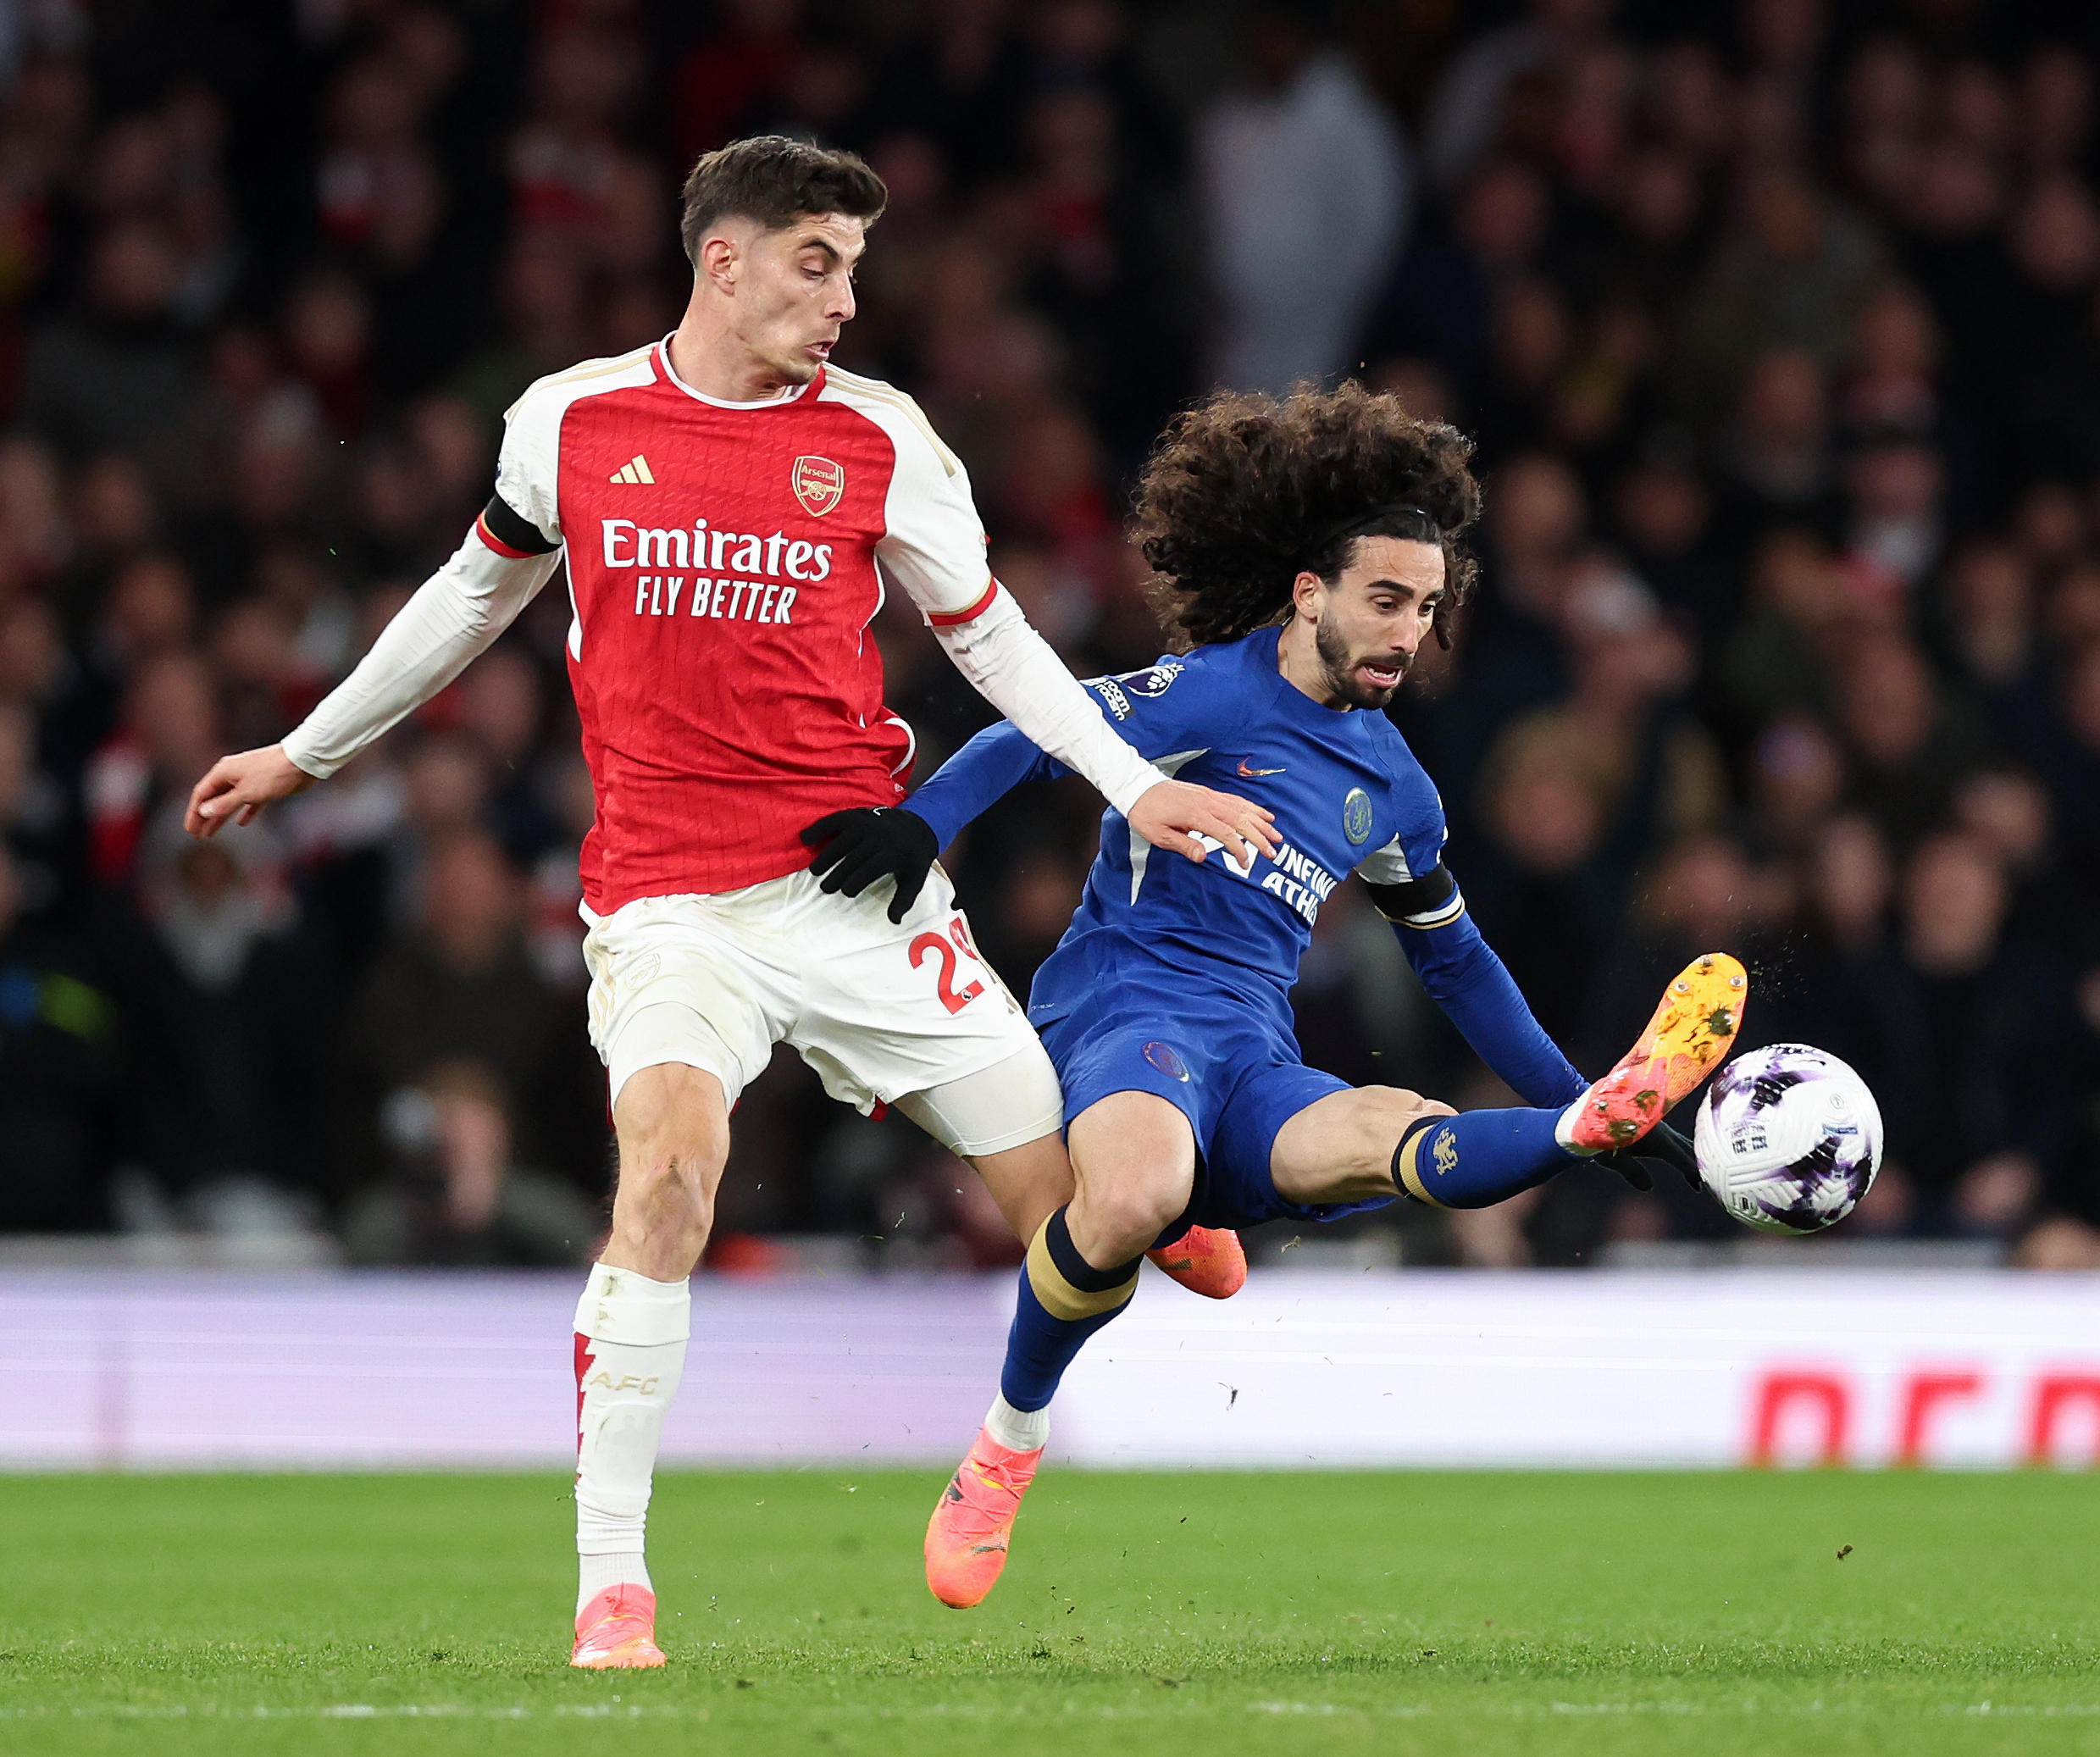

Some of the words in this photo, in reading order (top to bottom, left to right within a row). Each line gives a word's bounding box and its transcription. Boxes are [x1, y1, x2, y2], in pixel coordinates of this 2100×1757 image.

[801, 465, 836, 481] Arsenal
[601, 518, 833, 582] Emirates
[635, 575, 684, 616] FLY
[690, 577, 798, 624] BETTER
[1103, 679, 1131, 713] room
[590, 1371, 659, 1396] AFC
